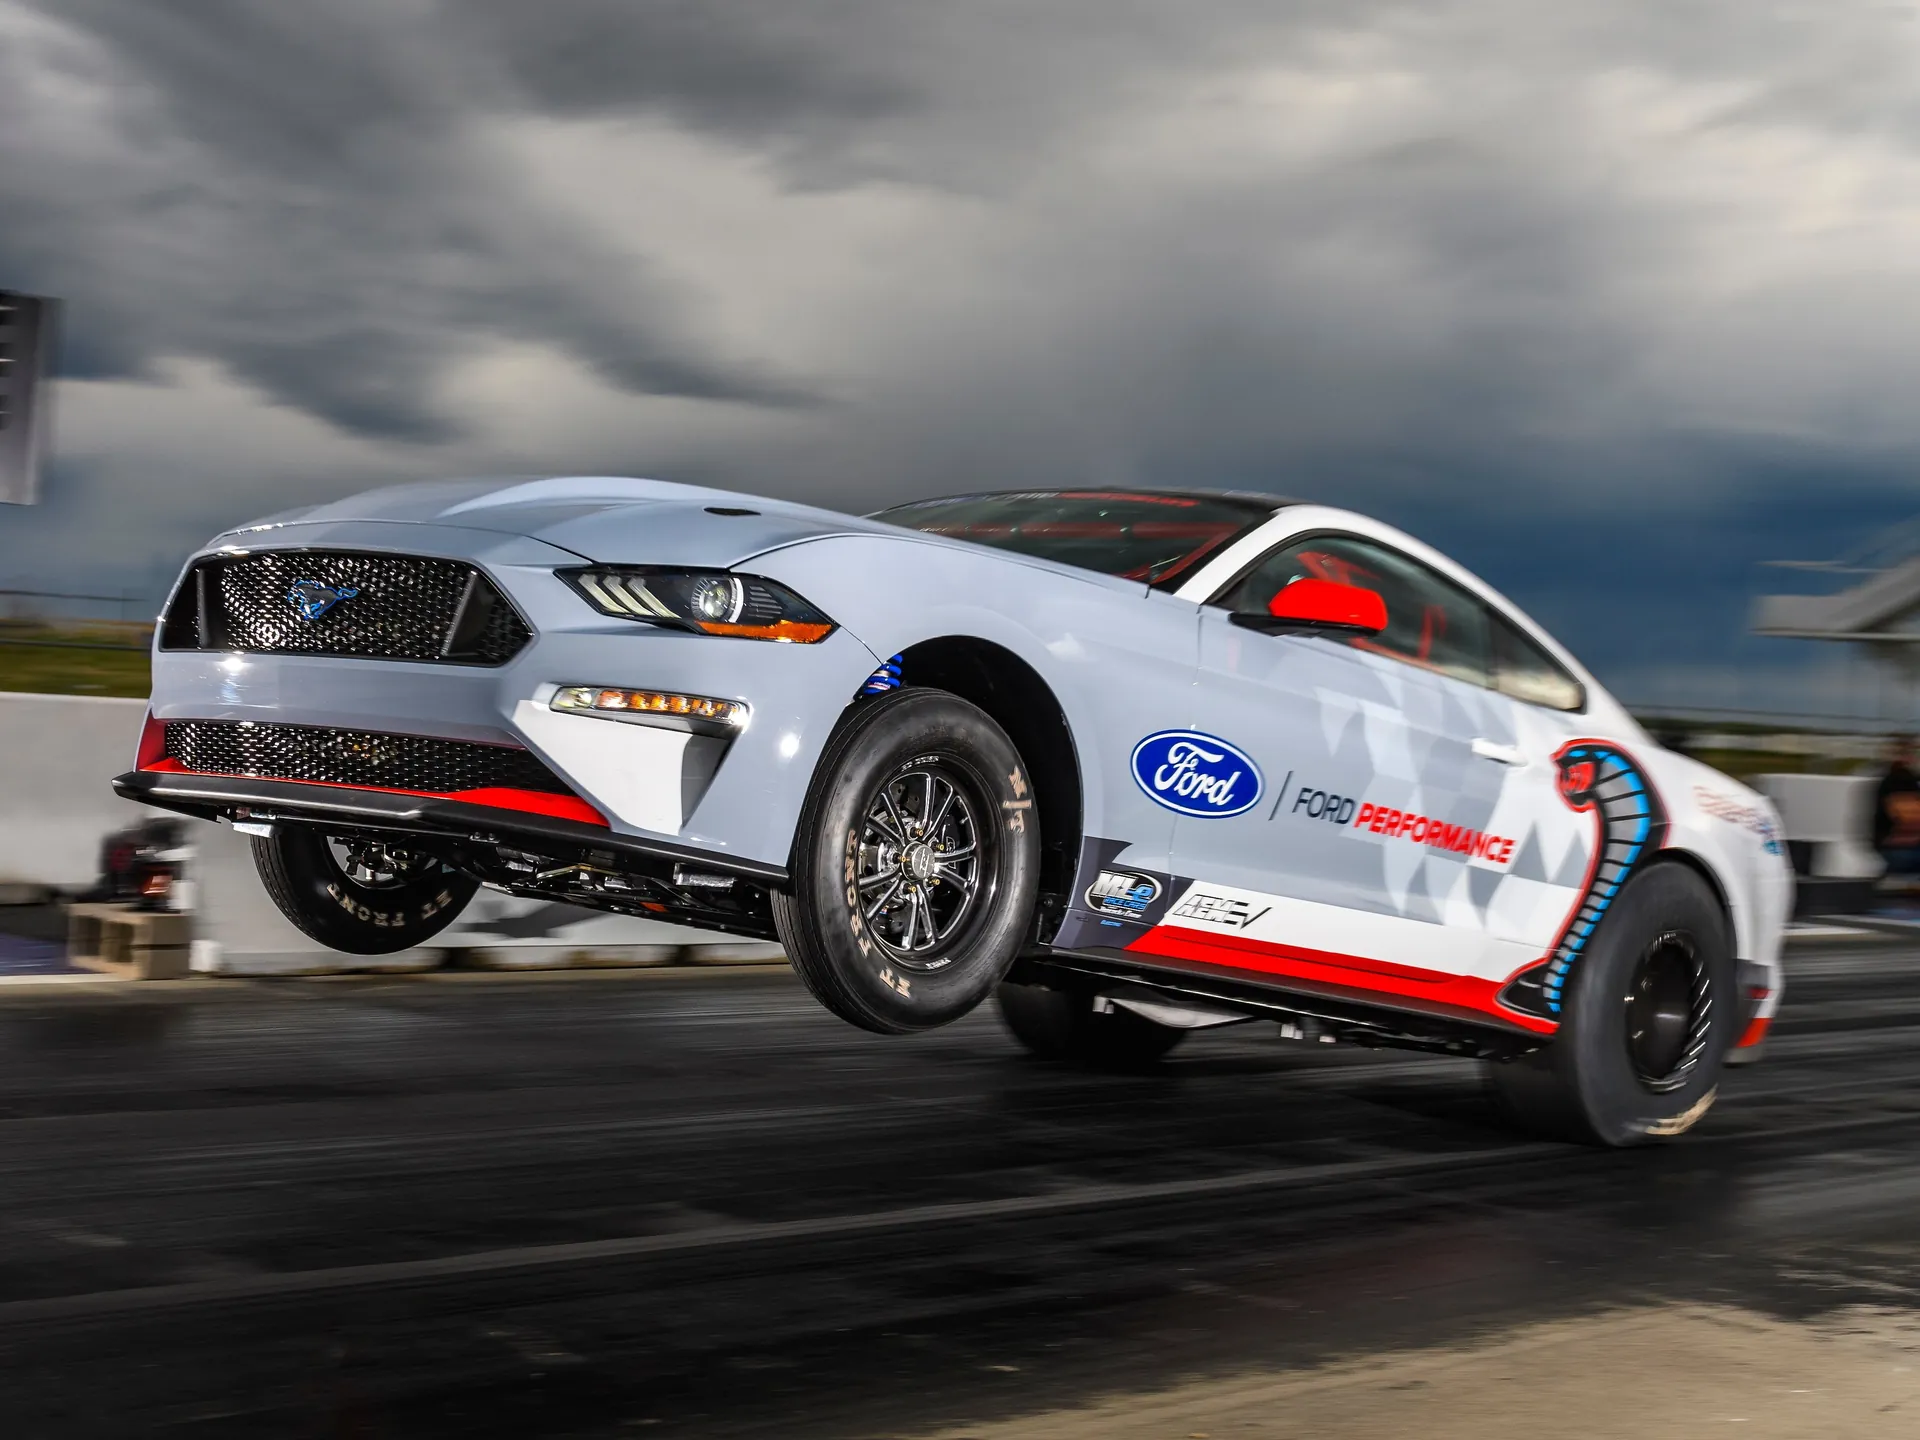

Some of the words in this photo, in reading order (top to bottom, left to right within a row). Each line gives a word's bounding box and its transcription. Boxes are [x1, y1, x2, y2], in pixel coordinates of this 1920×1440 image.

[1154, 742, 1241, 806] Ford
[1292, 787, 1356, 824] FORD
[1353, 803, 1516, 863] PERFORMANCE
[327, 882, 406, 927] FRONT
[845, 829, 872, 957] FRONT
